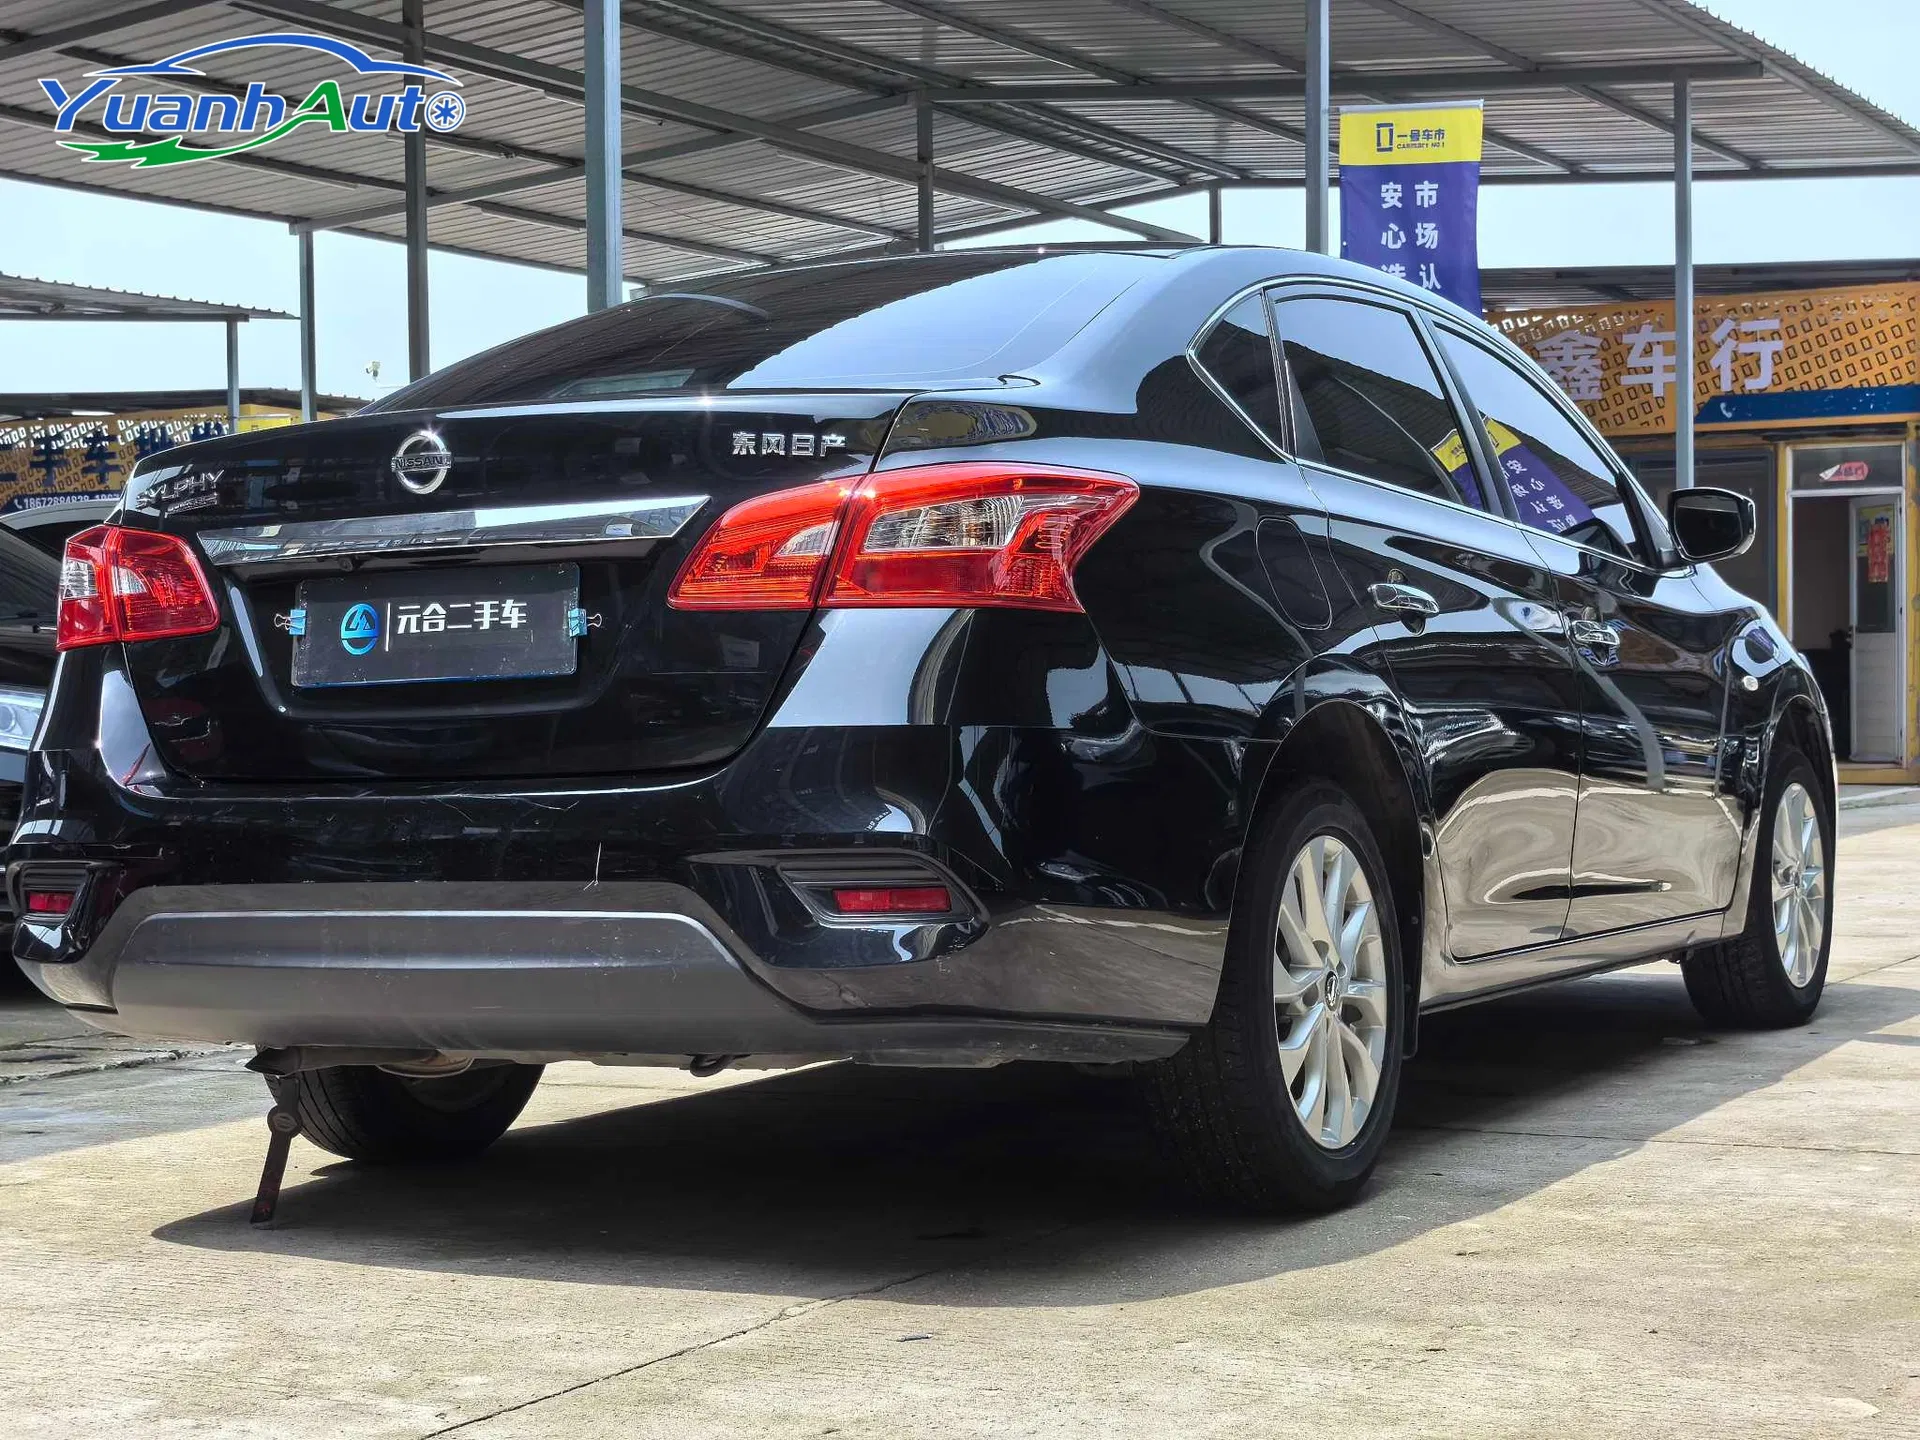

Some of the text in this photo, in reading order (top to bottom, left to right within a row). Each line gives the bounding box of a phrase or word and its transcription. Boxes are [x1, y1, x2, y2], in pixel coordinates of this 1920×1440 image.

[732, 431, 846, 457] 东风日产
[395, 454, 443, 470] NISSAN
[397, 599, 527, 634] 元合二手车
